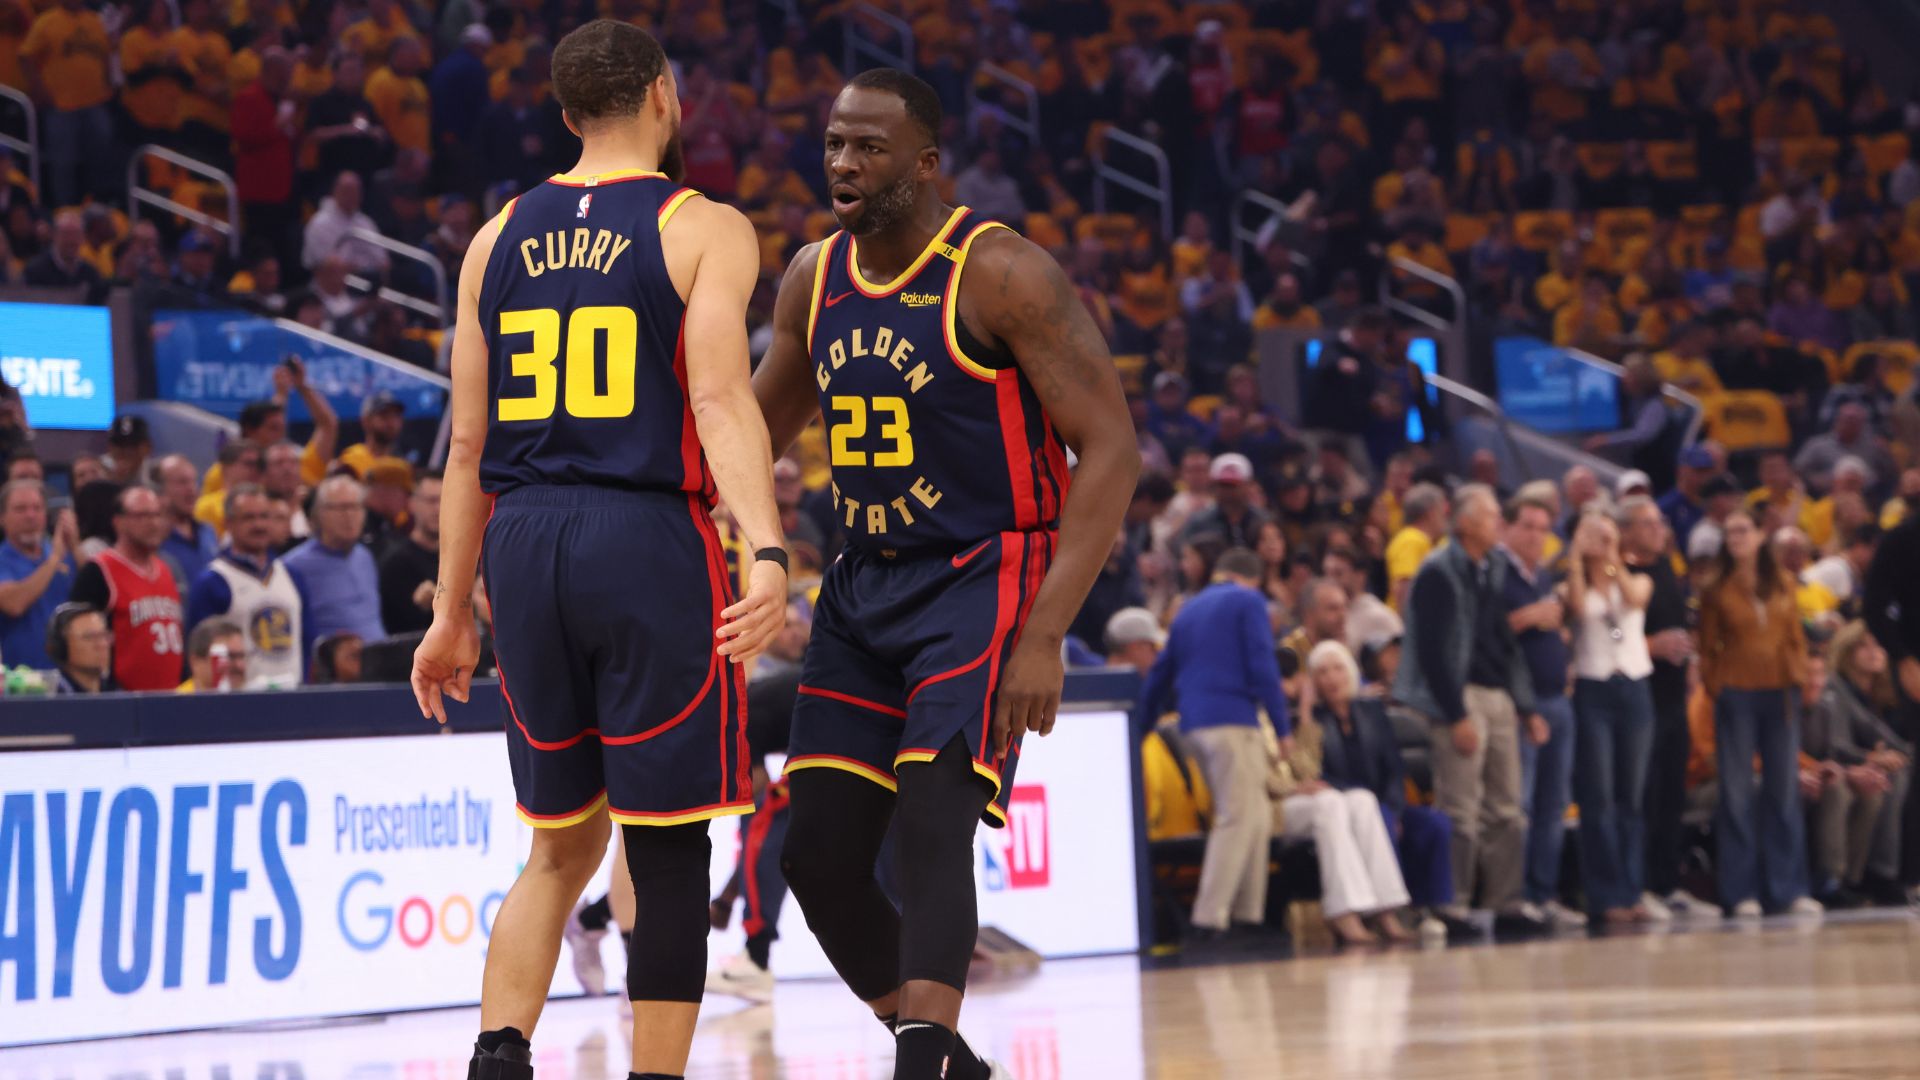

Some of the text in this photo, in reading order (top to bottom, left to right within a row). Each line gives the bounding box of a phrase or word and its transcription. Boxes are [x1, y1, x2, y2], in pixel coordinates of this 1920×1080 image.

[520, 227, 632, 278] CURRY
[943, 246, 954, 257] 16
[900, 292, 941, 305] Rakuten
[498, 306, 637, 421] 30
[816, 326, 935, 394] GOLDEN
[830, 395, 914, 467] 23
[832, 476, 943, 534] STATE
[335, 787, 492, 855] Presented by
